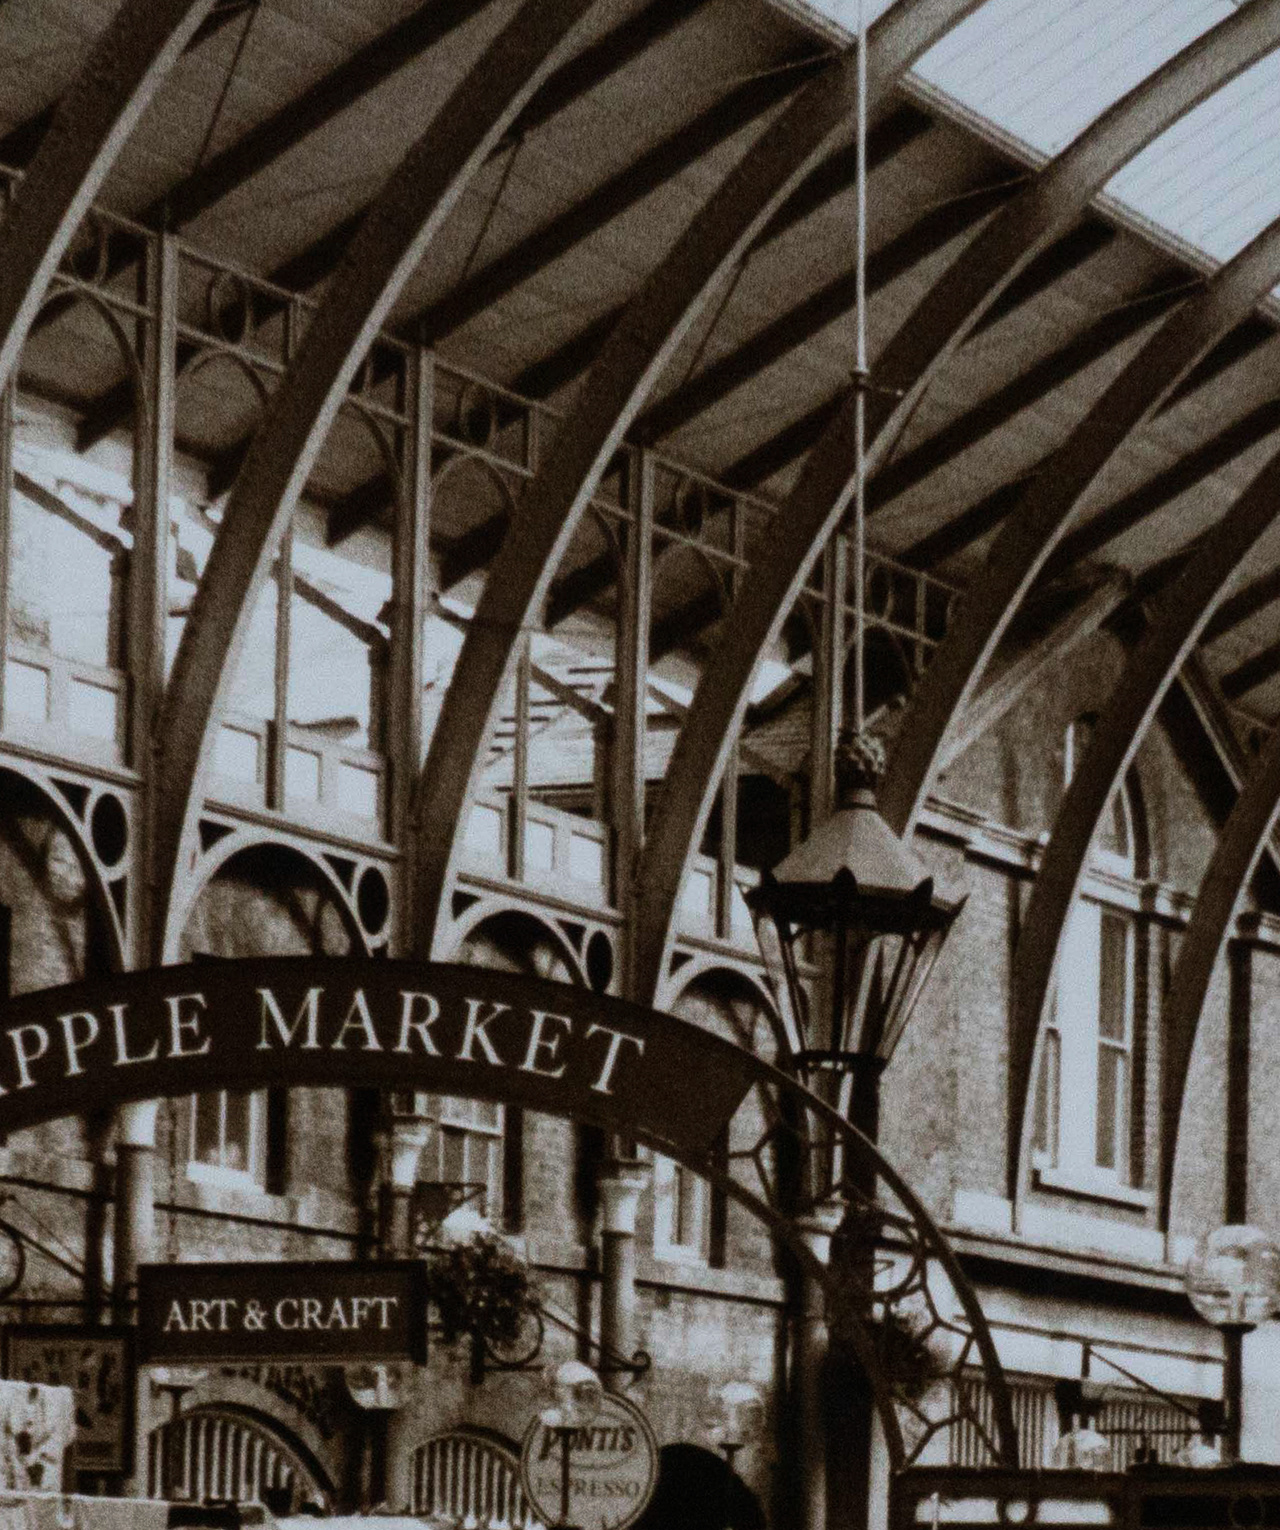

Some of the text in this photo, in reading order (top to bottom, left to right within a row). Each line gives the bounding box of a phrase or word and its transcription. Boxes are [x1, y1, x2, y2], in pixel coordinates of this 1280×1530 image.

[256, 987, 644, 1094] MARKET
[163, 1296, 398, 1331] ART & CRAFT
[536, 1477, 641, 1497] ESRESSO
